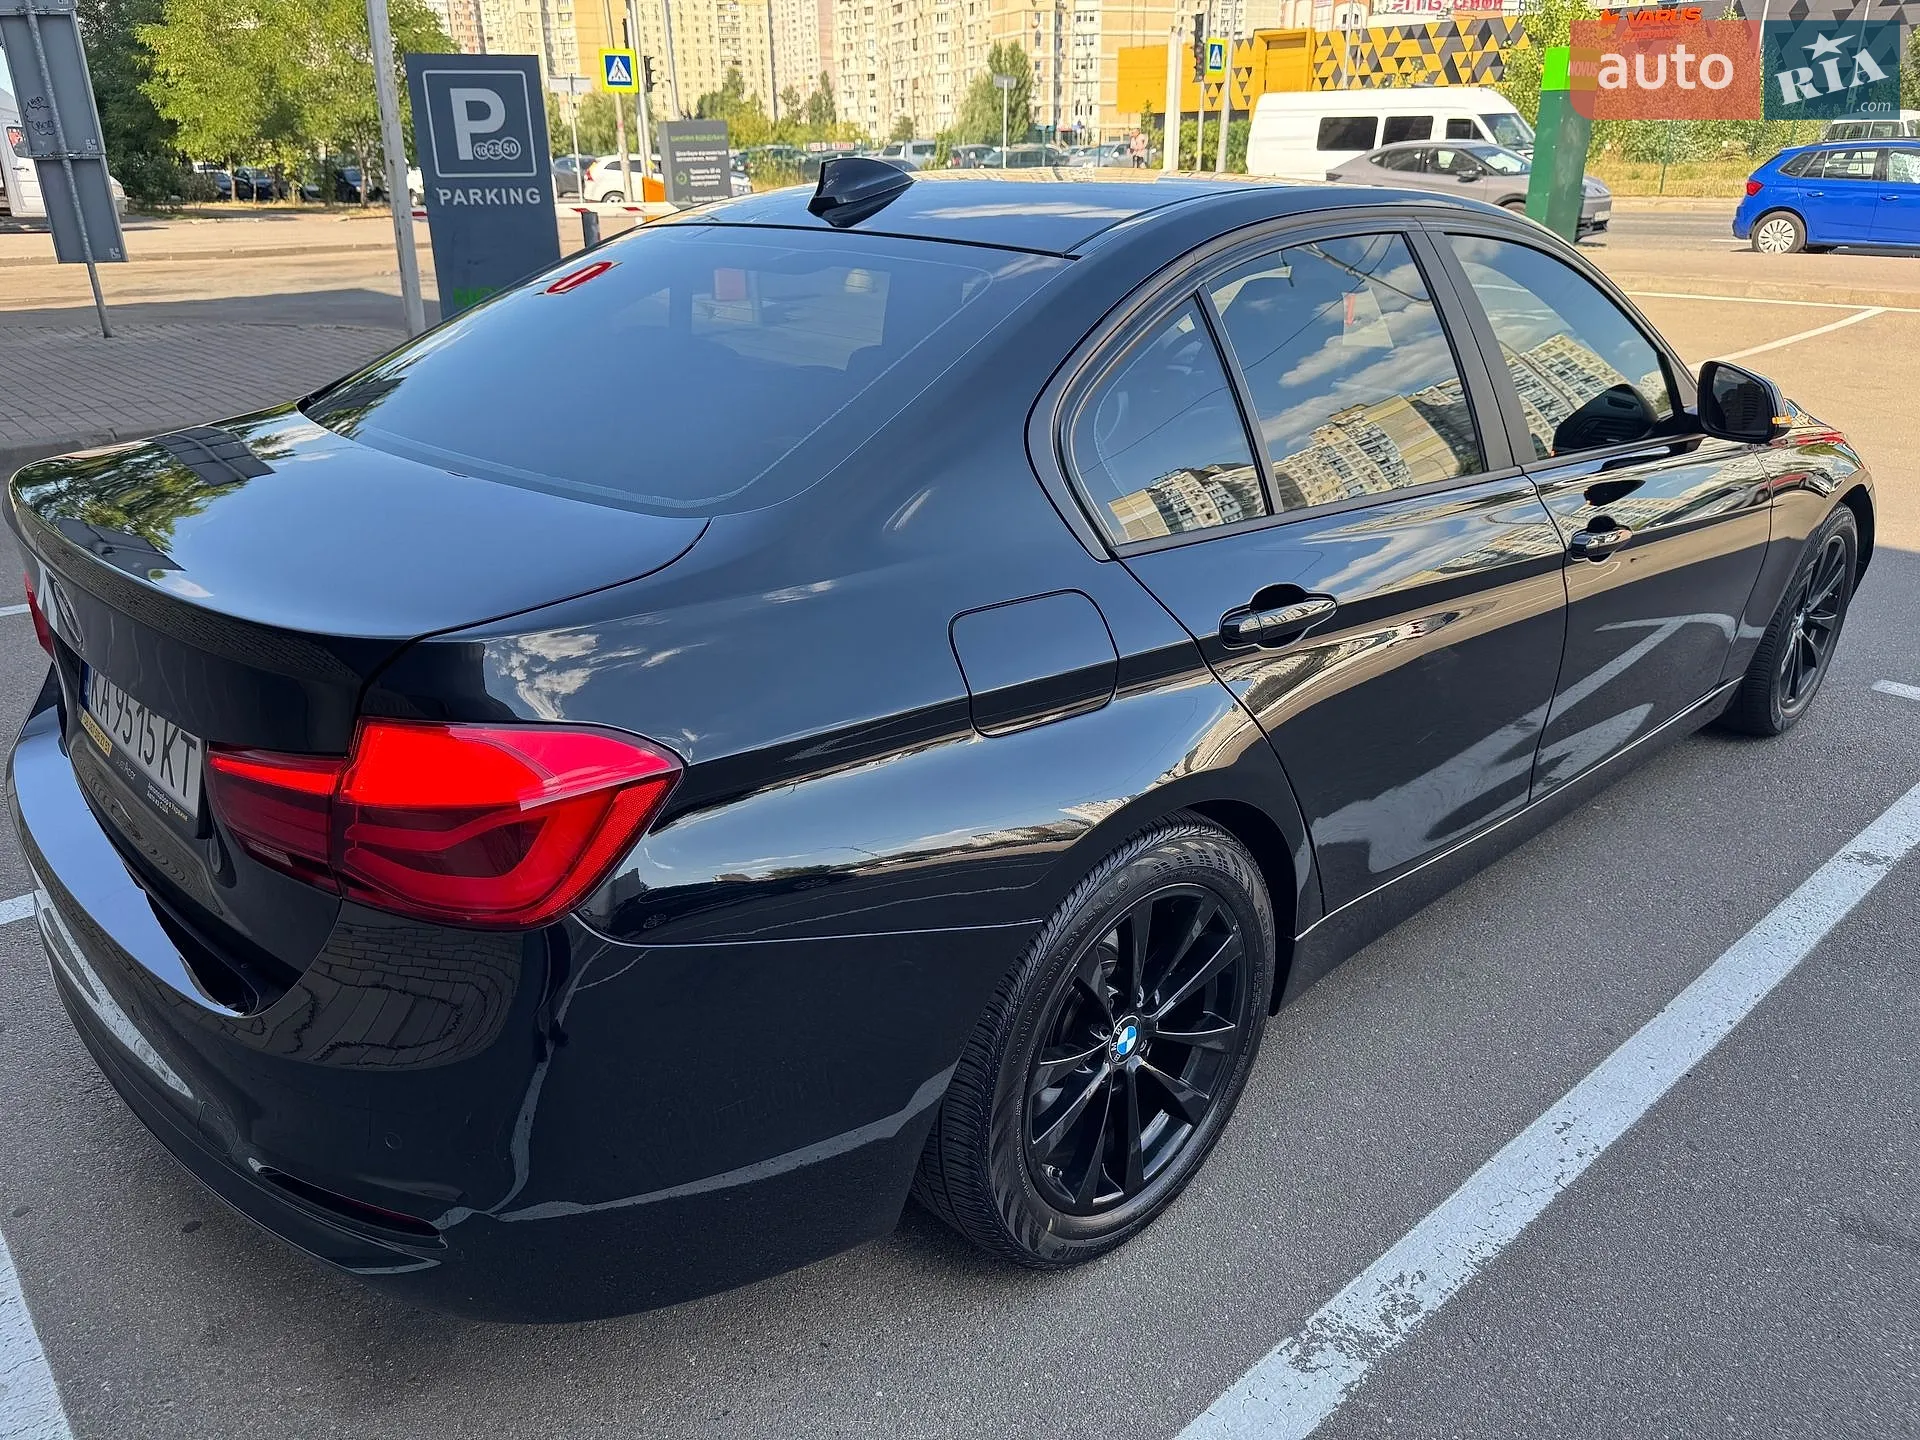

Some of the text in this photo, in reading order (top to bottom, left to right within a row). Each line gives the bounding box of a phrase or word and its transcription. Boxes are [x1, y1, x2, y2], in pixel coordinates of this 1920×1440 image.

[1627, 7, 1701, 29] VARUS
[1567, 60, 1598, 77] NOVUS
[450, 88, 506, 160] P
[503, 142, 517, 154] 50
[436, 187, 541, 206] PARKING
[113, 688, 157, 765] 9515
[160, 719, 197, 797] KT
